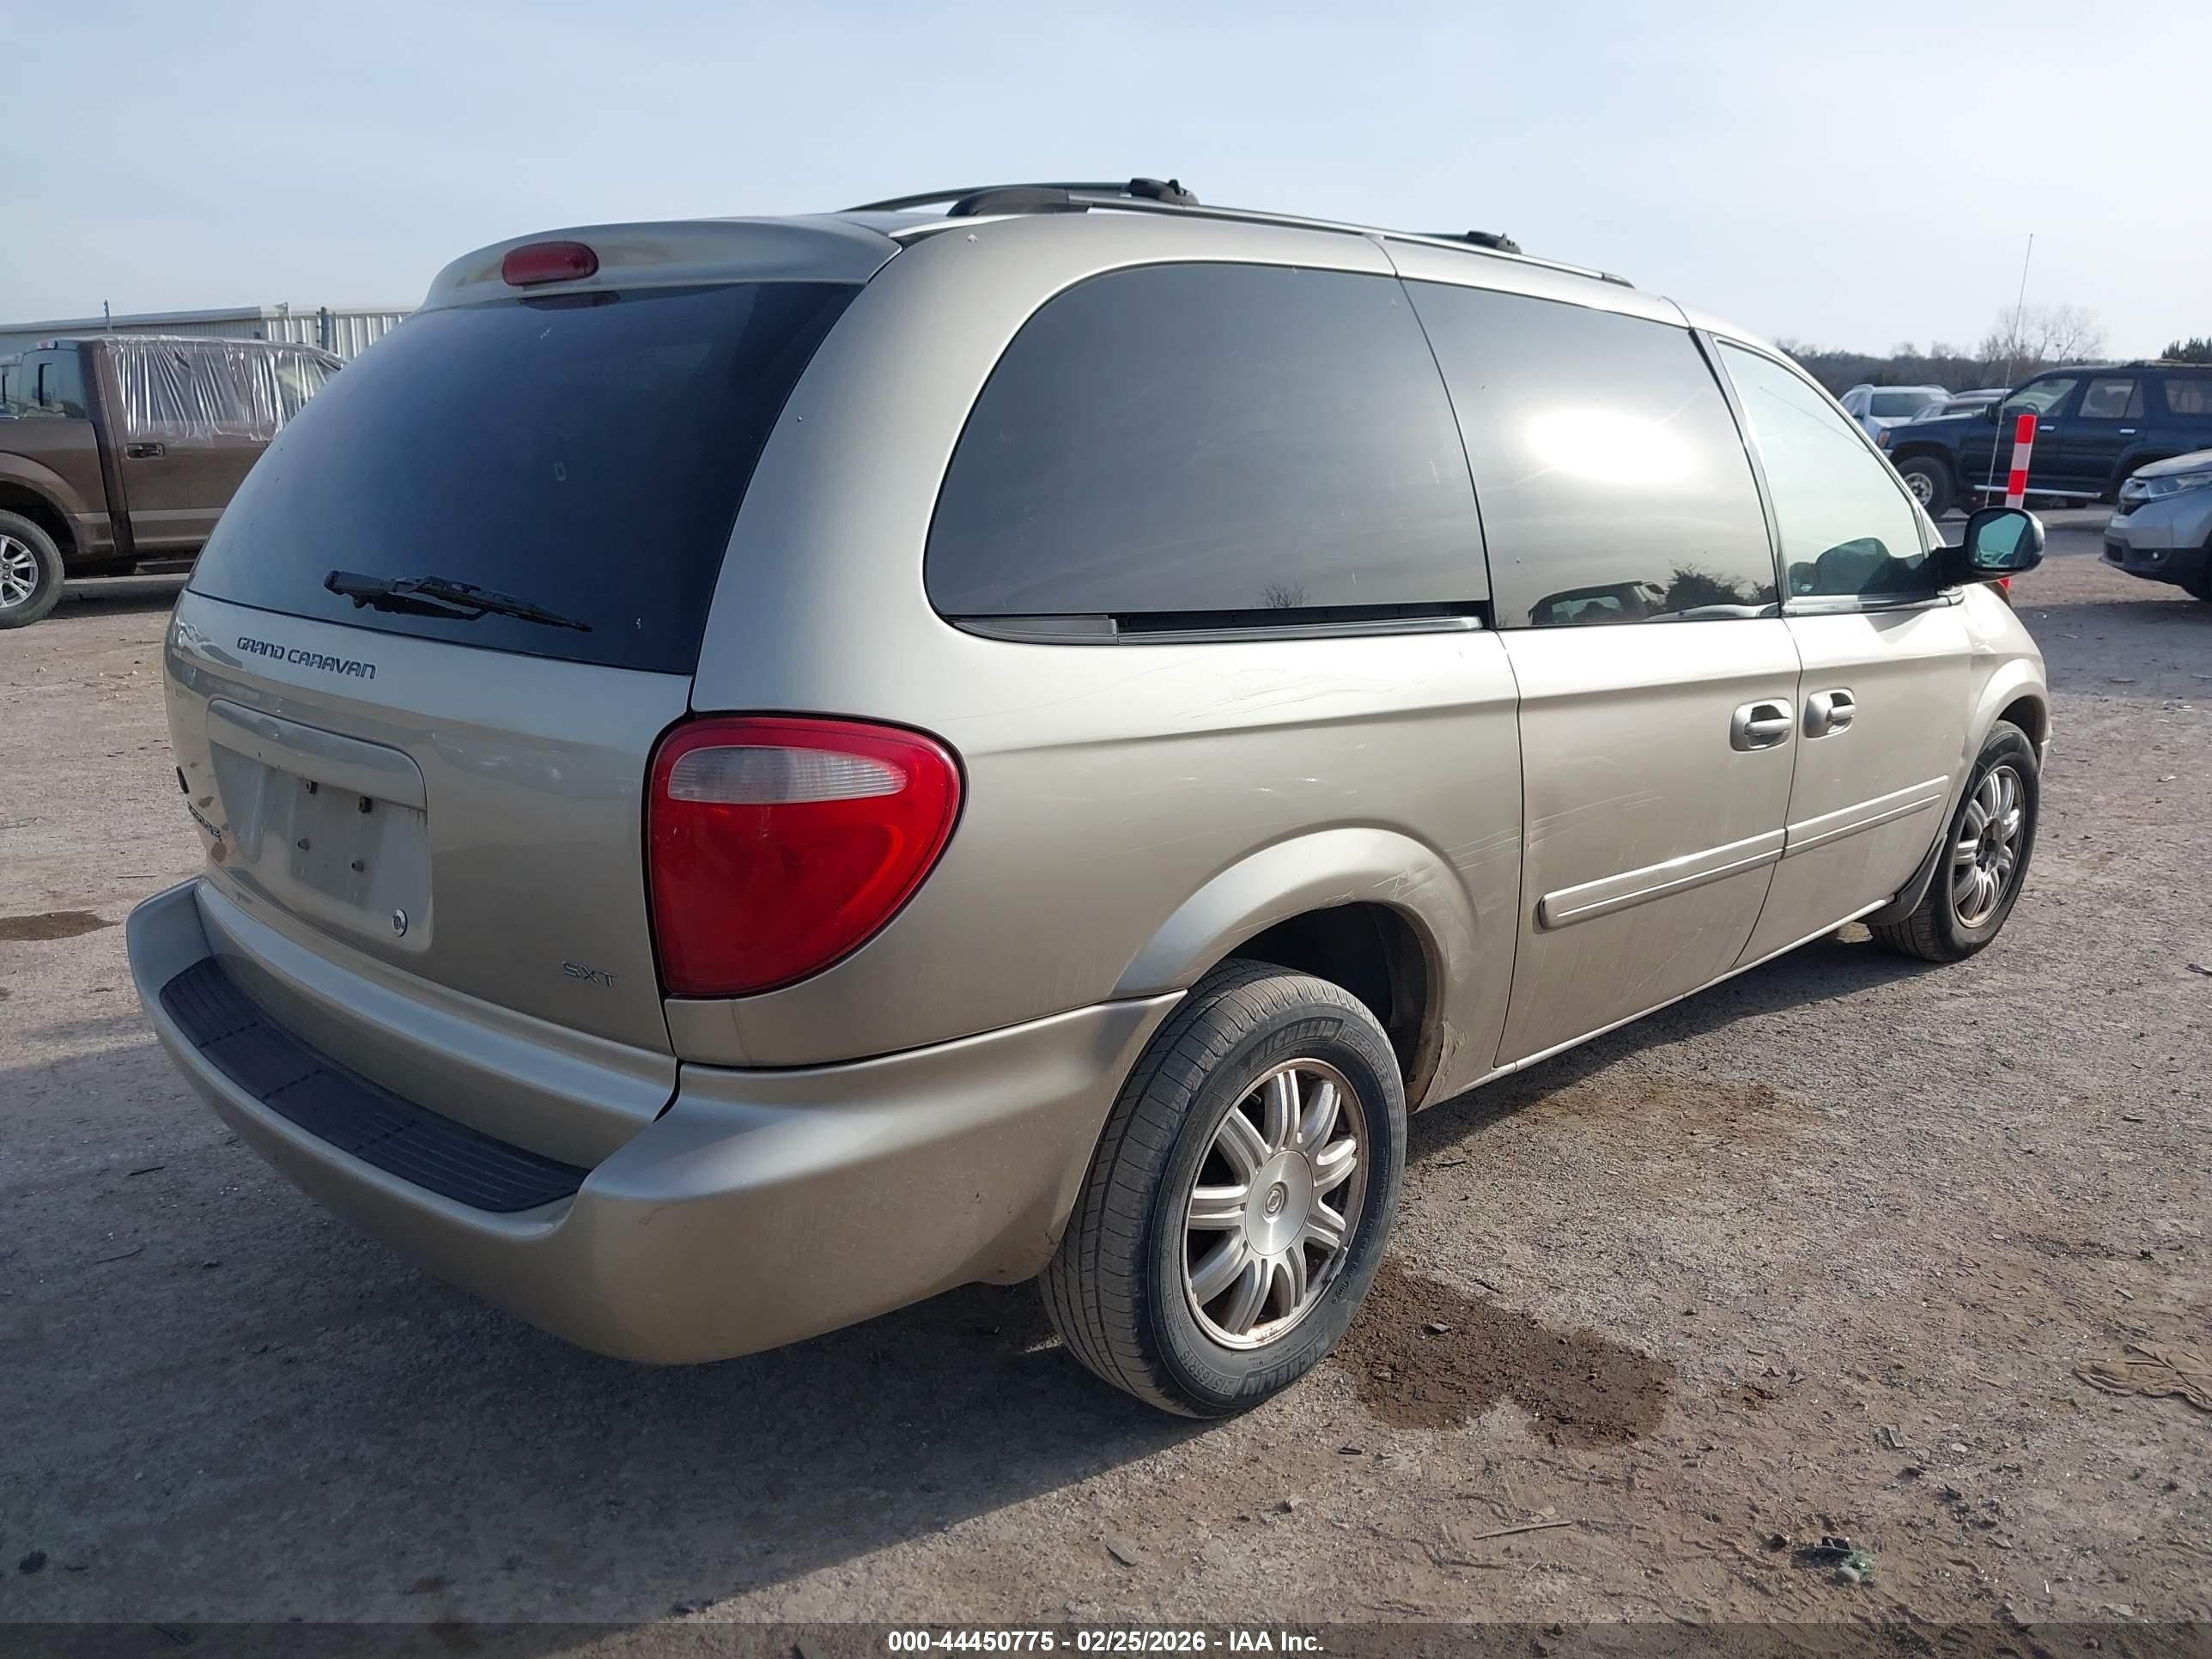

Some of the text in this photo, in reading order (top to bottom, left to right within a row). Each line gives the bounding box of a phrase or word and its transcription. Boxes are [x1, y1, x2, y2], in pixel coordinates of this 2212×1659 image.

[236, 636, 376, 679] GRAND CARAVAN
[562, 961, 618, 988] SXT
[1249, 1019, 1342, 1070] MICHELIN
